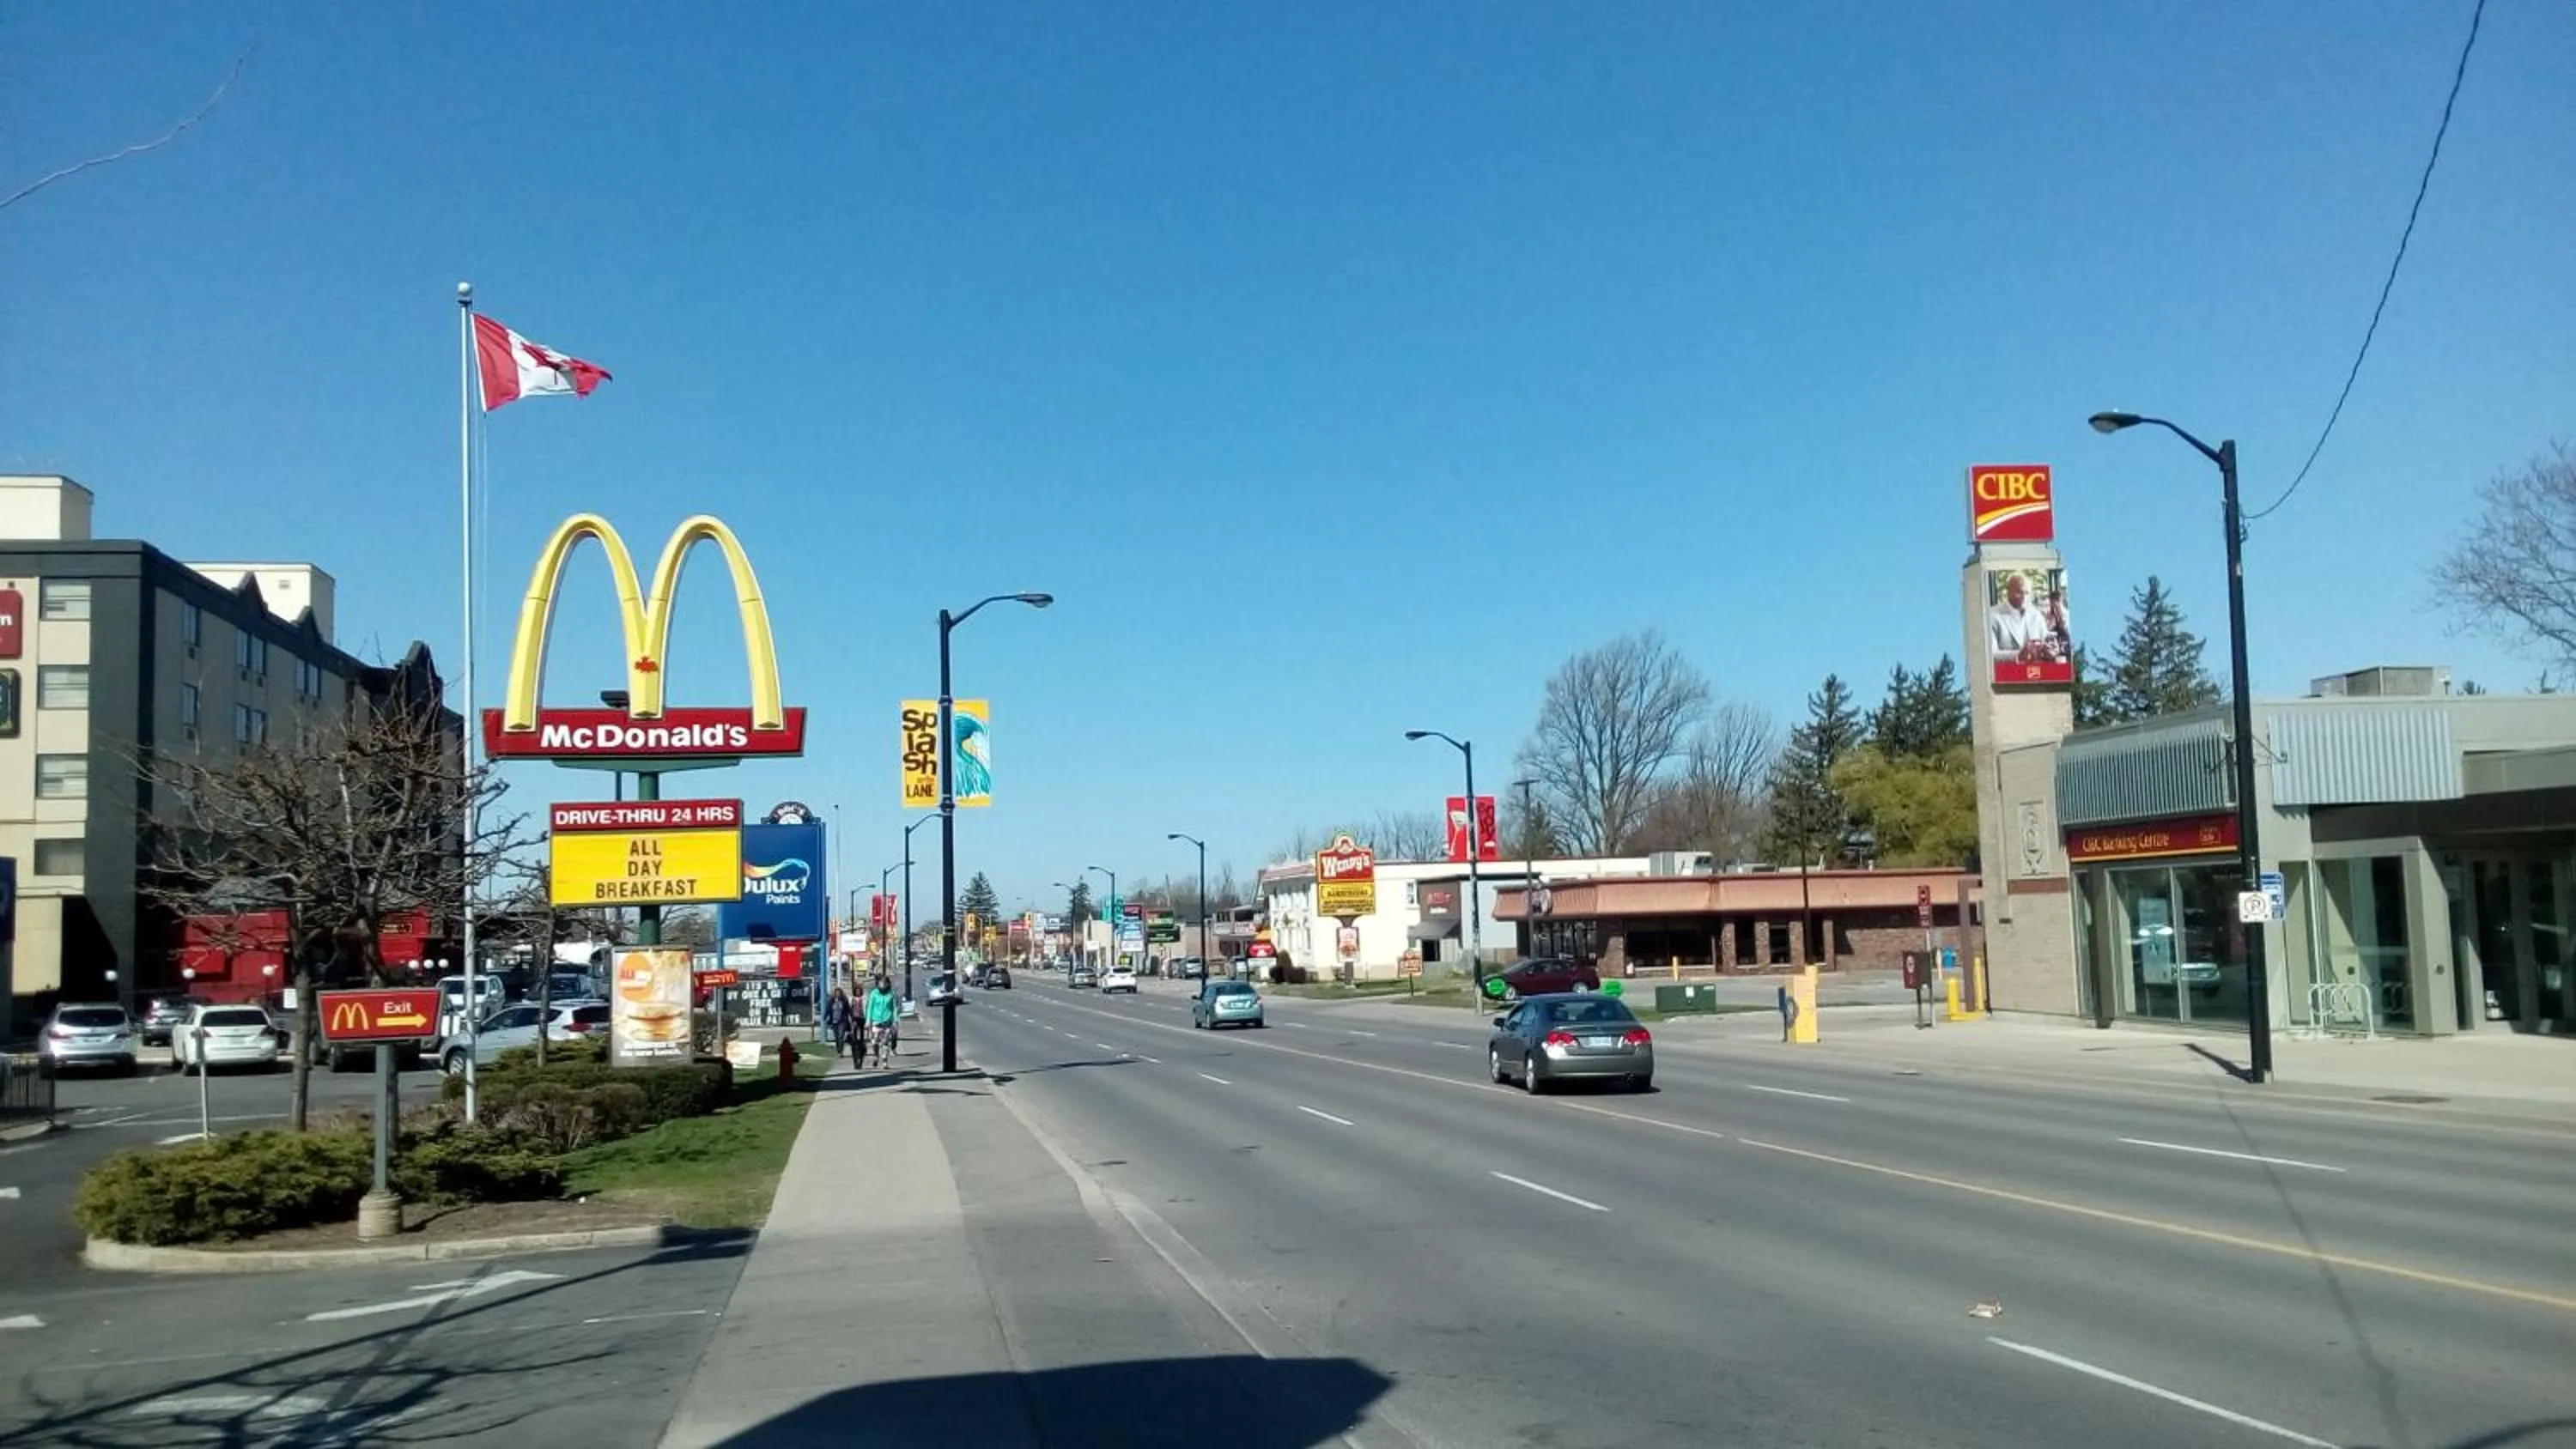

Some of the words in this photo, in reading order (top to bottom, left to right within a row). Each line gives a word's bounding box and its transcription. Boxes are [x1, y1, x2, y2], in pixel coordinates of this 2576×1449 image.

[1977, 472, 2046, 500] CIBC
[539, 723, 749, 749] McDonald's
[906, 784, 934, 797] LANE
[555, 808, 666, 826] DRIVE-THRU
[671, 808, 692, 822] 24
[696, 805, 734, 822] HRS
[629, 839, 663, 857] ALL
[627, 859, 663, 877] DAY
[595, 878, 697, 900] BREAKFAST
[766, 894, 801, 905] Paints
[383, 1001, 412, 1014] Exit
